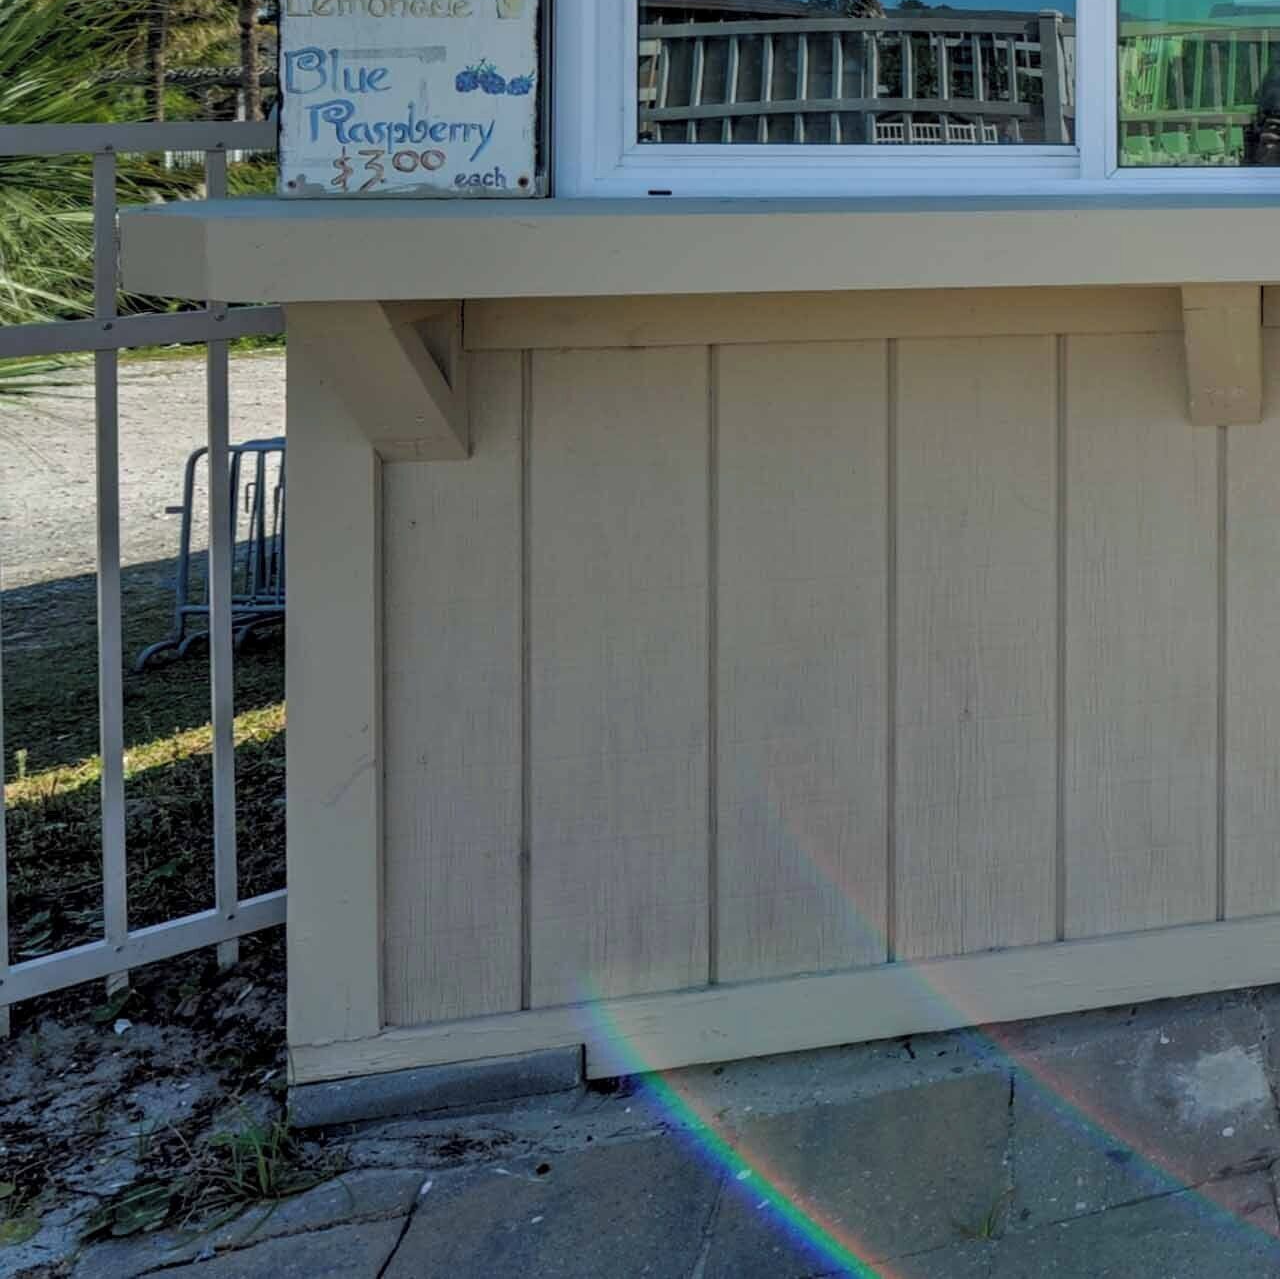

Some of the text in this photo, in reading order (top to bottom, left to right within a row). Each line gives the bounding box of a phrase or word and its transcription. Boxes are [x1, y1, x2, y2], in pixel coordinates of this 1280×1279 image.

[284, 46, 392, 95] Blue
[304, 98, 496, 163] Raspberry
[453, 166, 507, 190] each
